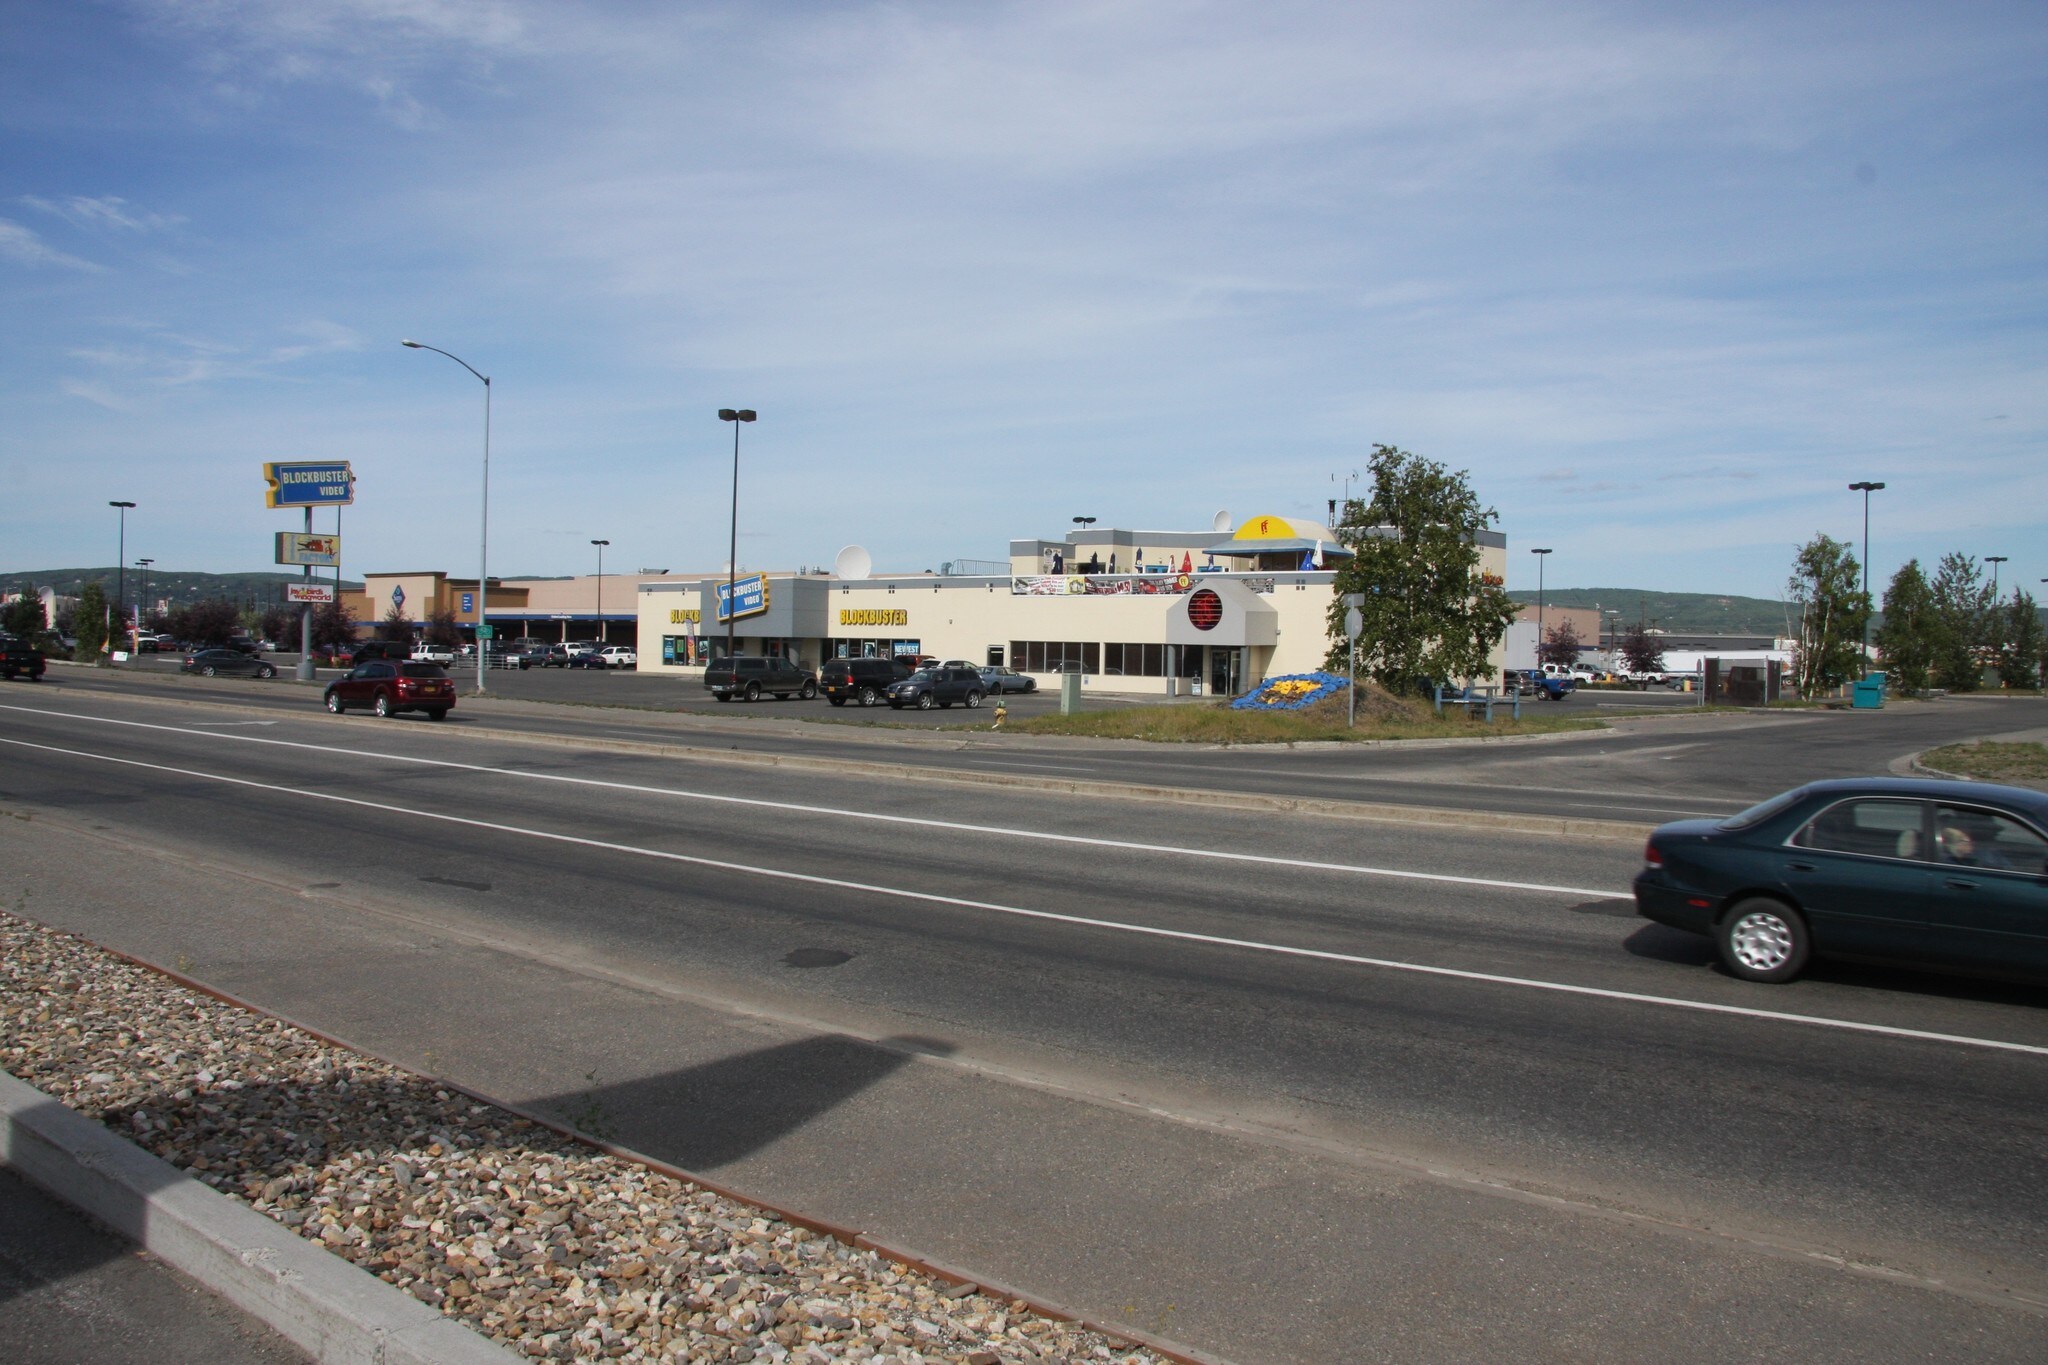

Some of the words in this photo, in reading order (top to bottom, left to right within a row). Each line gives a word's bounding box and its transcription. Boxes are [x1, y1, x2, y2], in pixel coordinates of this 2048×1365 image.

[283, 471, 349, 484] BLOCKBUSTER
[320, 487, 344, 496] VIDEO
[722, 581, 762, 600] BLCKBUSTER
[743, 597, 760, 606] VIDEO
[840, 609, 907, 626] BLOCKBUSTER
[894, 645, 919, 653] NEWEST
